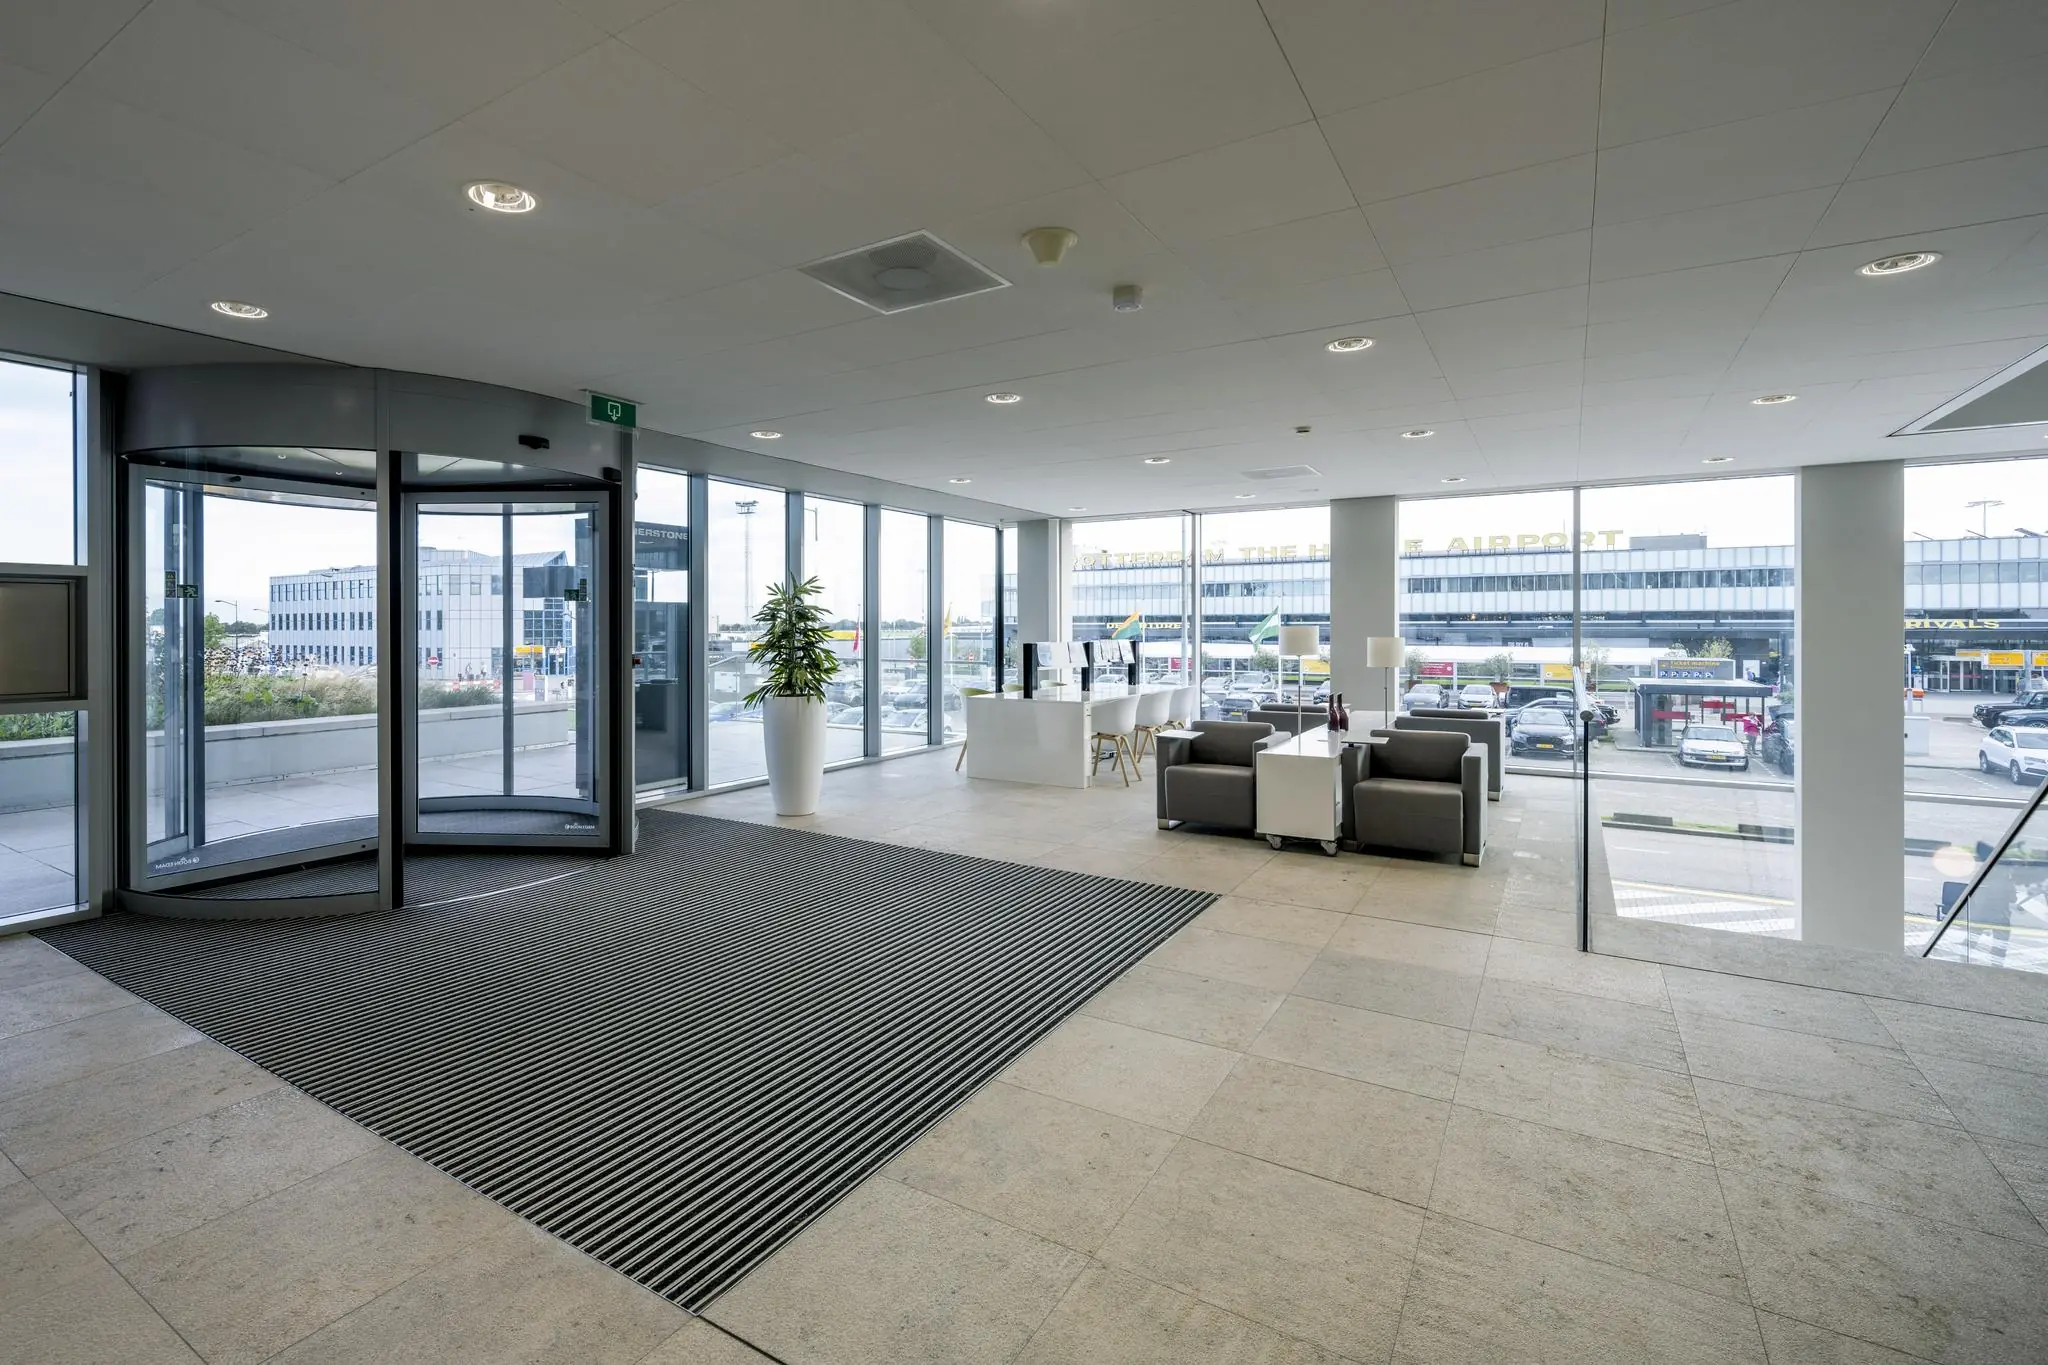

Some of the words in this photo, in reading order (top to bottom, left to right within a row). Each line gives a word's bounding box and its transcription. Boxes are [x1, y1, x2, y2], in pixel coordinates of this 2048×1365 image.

[1073, 547, 1224, 567] OTTERDM
[1239, 545, 1297, 560] THE
[1448, 530, 1624, 551] AIRPORT
[1903, 618, 2000, 629] RIVALS
